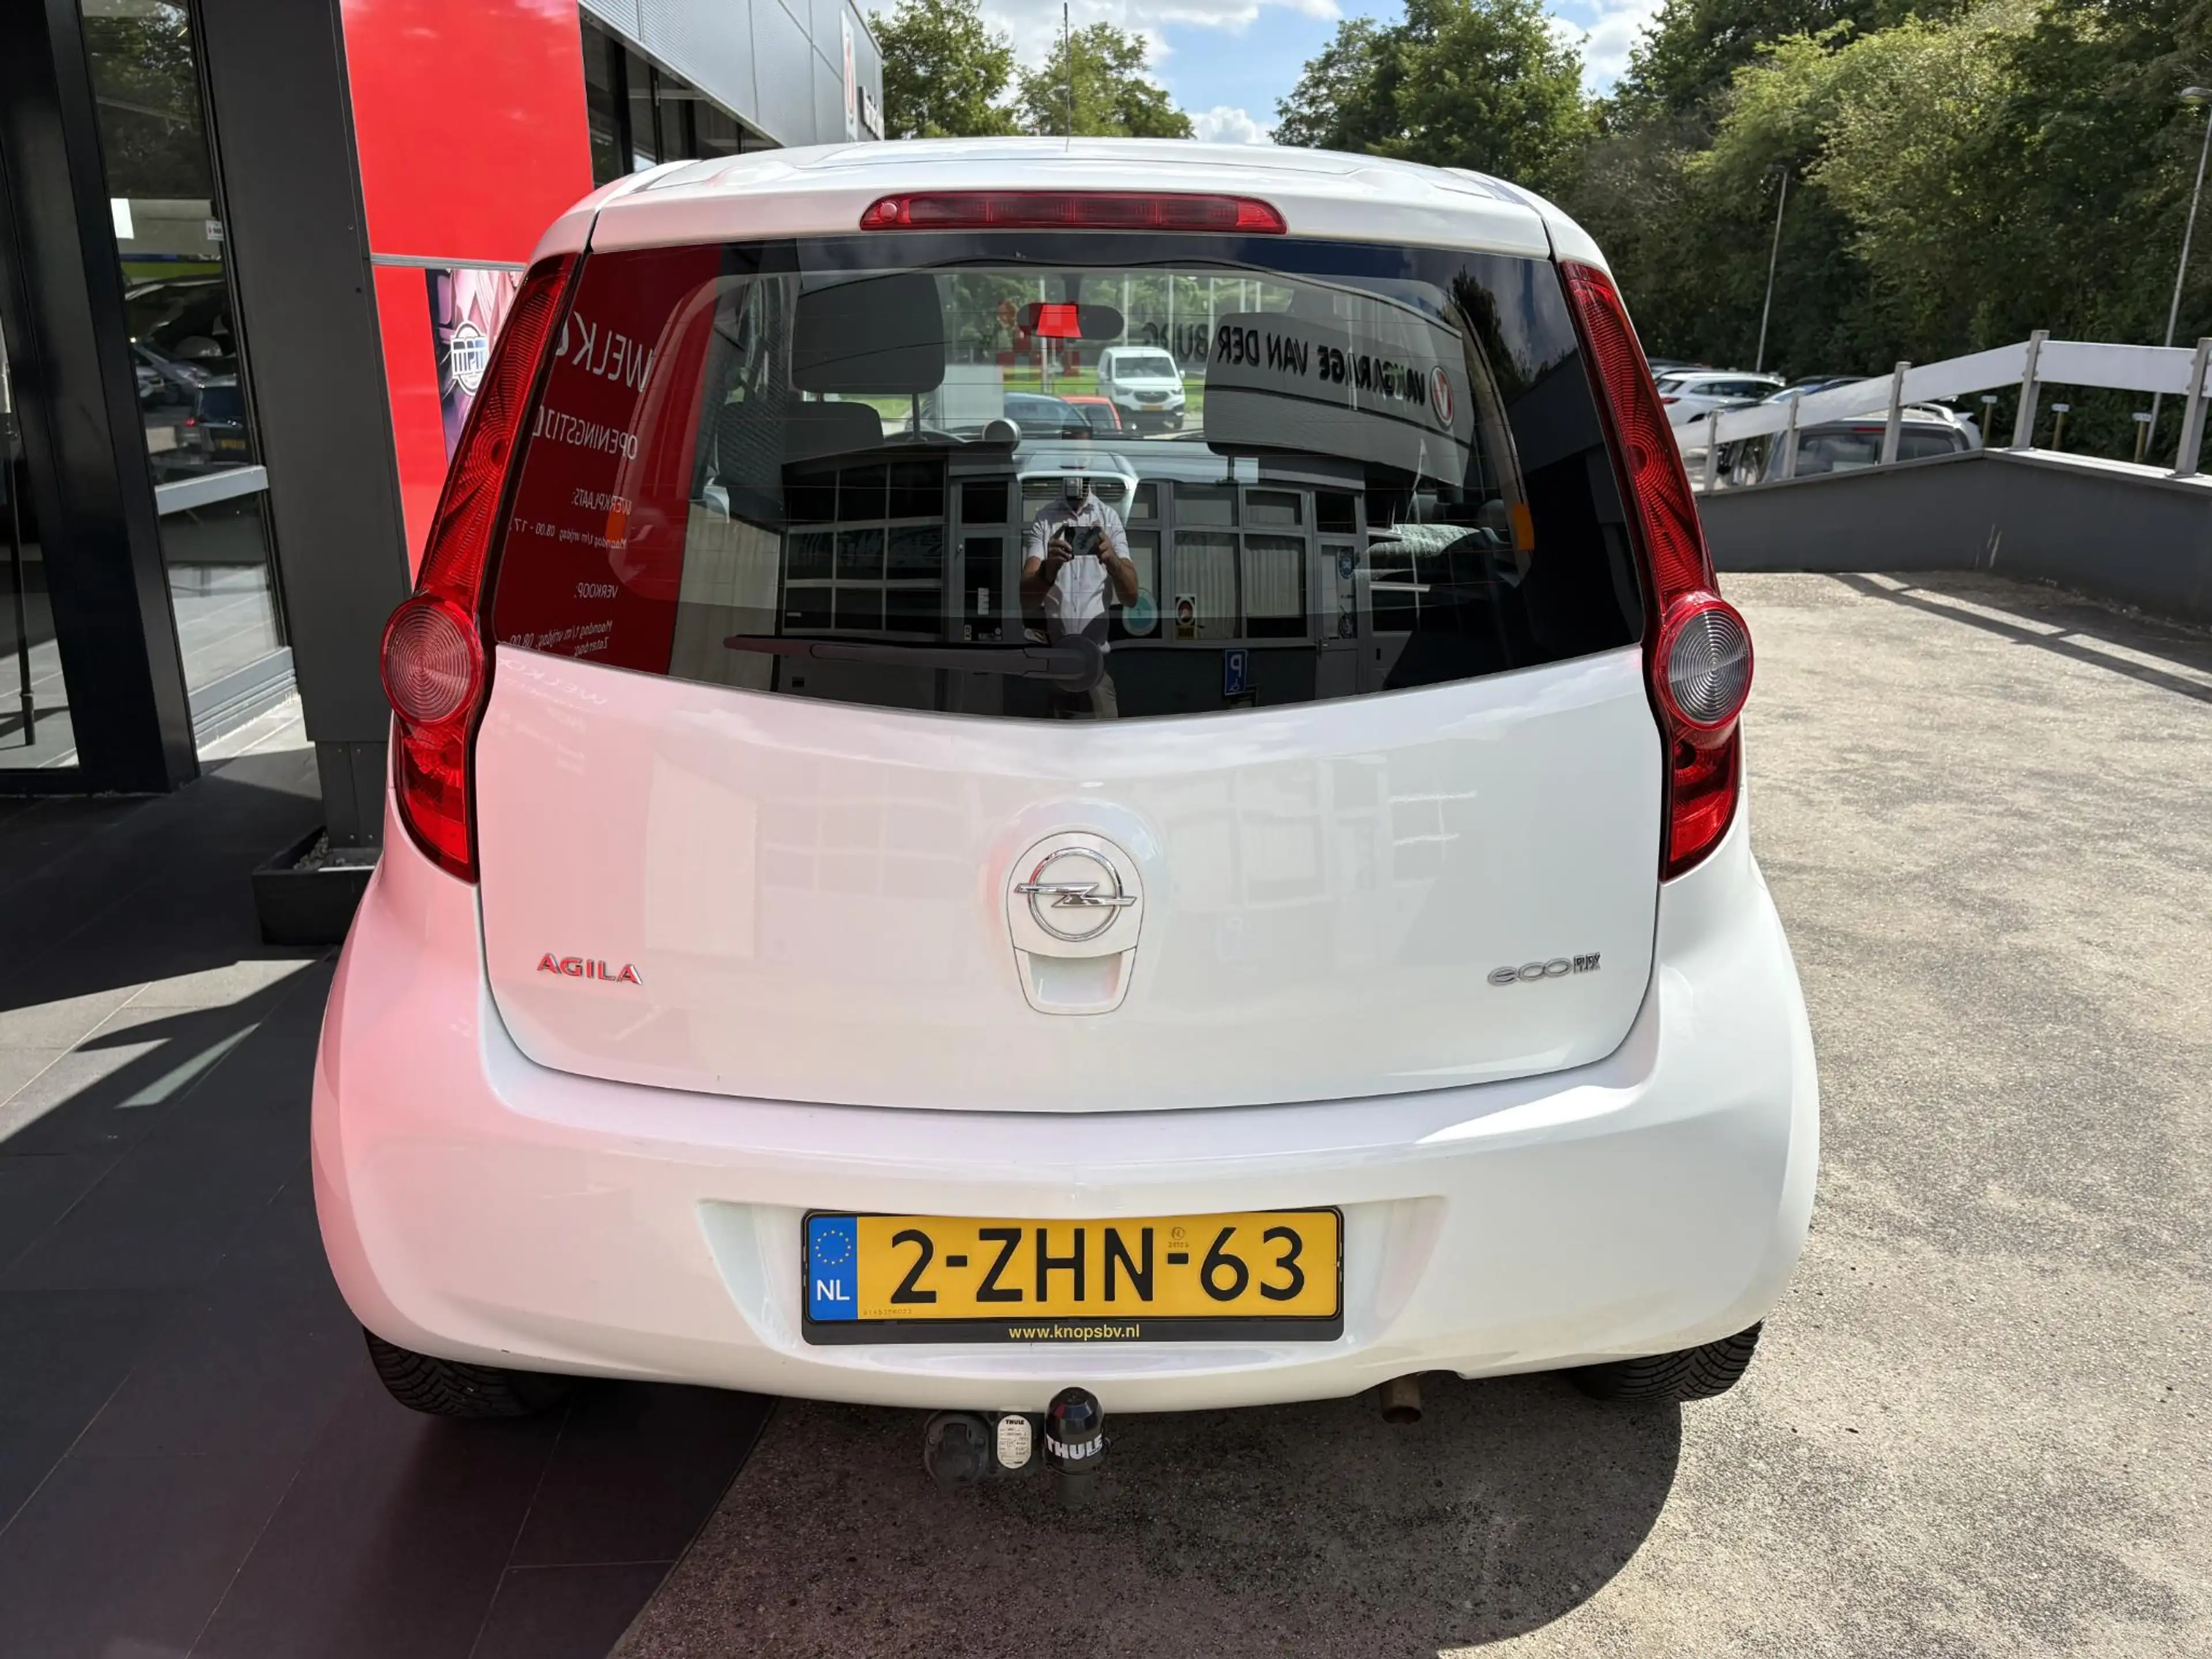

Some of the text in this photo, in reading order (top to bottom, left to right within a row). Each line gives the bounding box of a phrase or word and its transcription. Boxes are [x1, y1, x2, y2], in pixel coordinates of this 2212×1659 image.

[536, 952, 643, 986] AGILA
[816, 1226, 1305, 1304] NL 2-ZHN-63
[1009, 1324, 1140, 1341] www.knopsbv.nl
[1046, 1433, 1103, 1460] THULE
